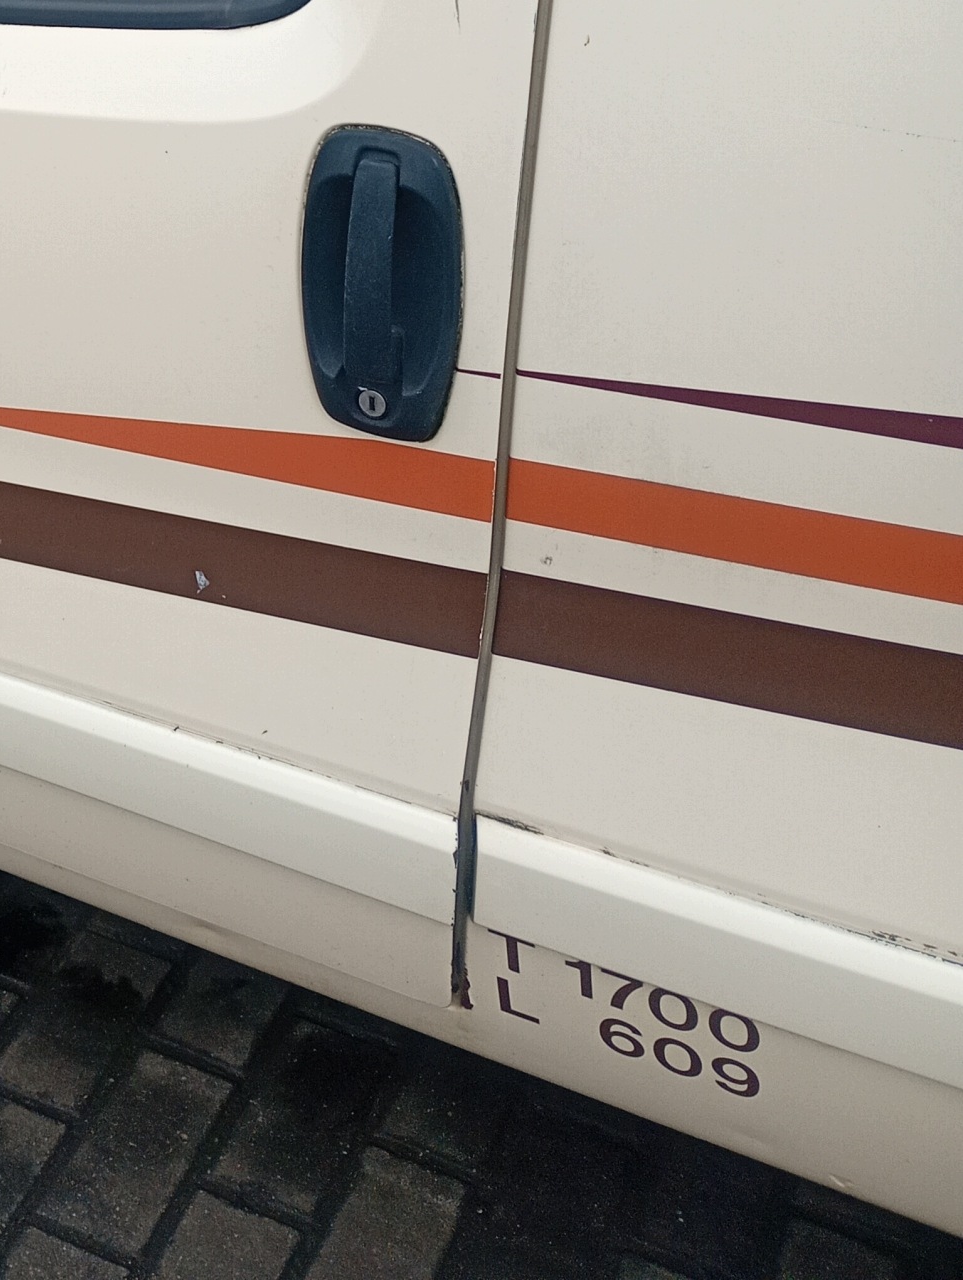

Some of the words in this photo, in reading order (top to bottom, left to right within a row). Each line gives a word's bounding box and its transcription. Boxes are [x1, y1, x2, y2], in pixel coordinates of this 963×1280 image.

[487, 927, 536, 974] T
[564, 959, 760, 1053] 1700
[497, 976, 540, 1025] L
[599, 1018, 760, 1098] 609
